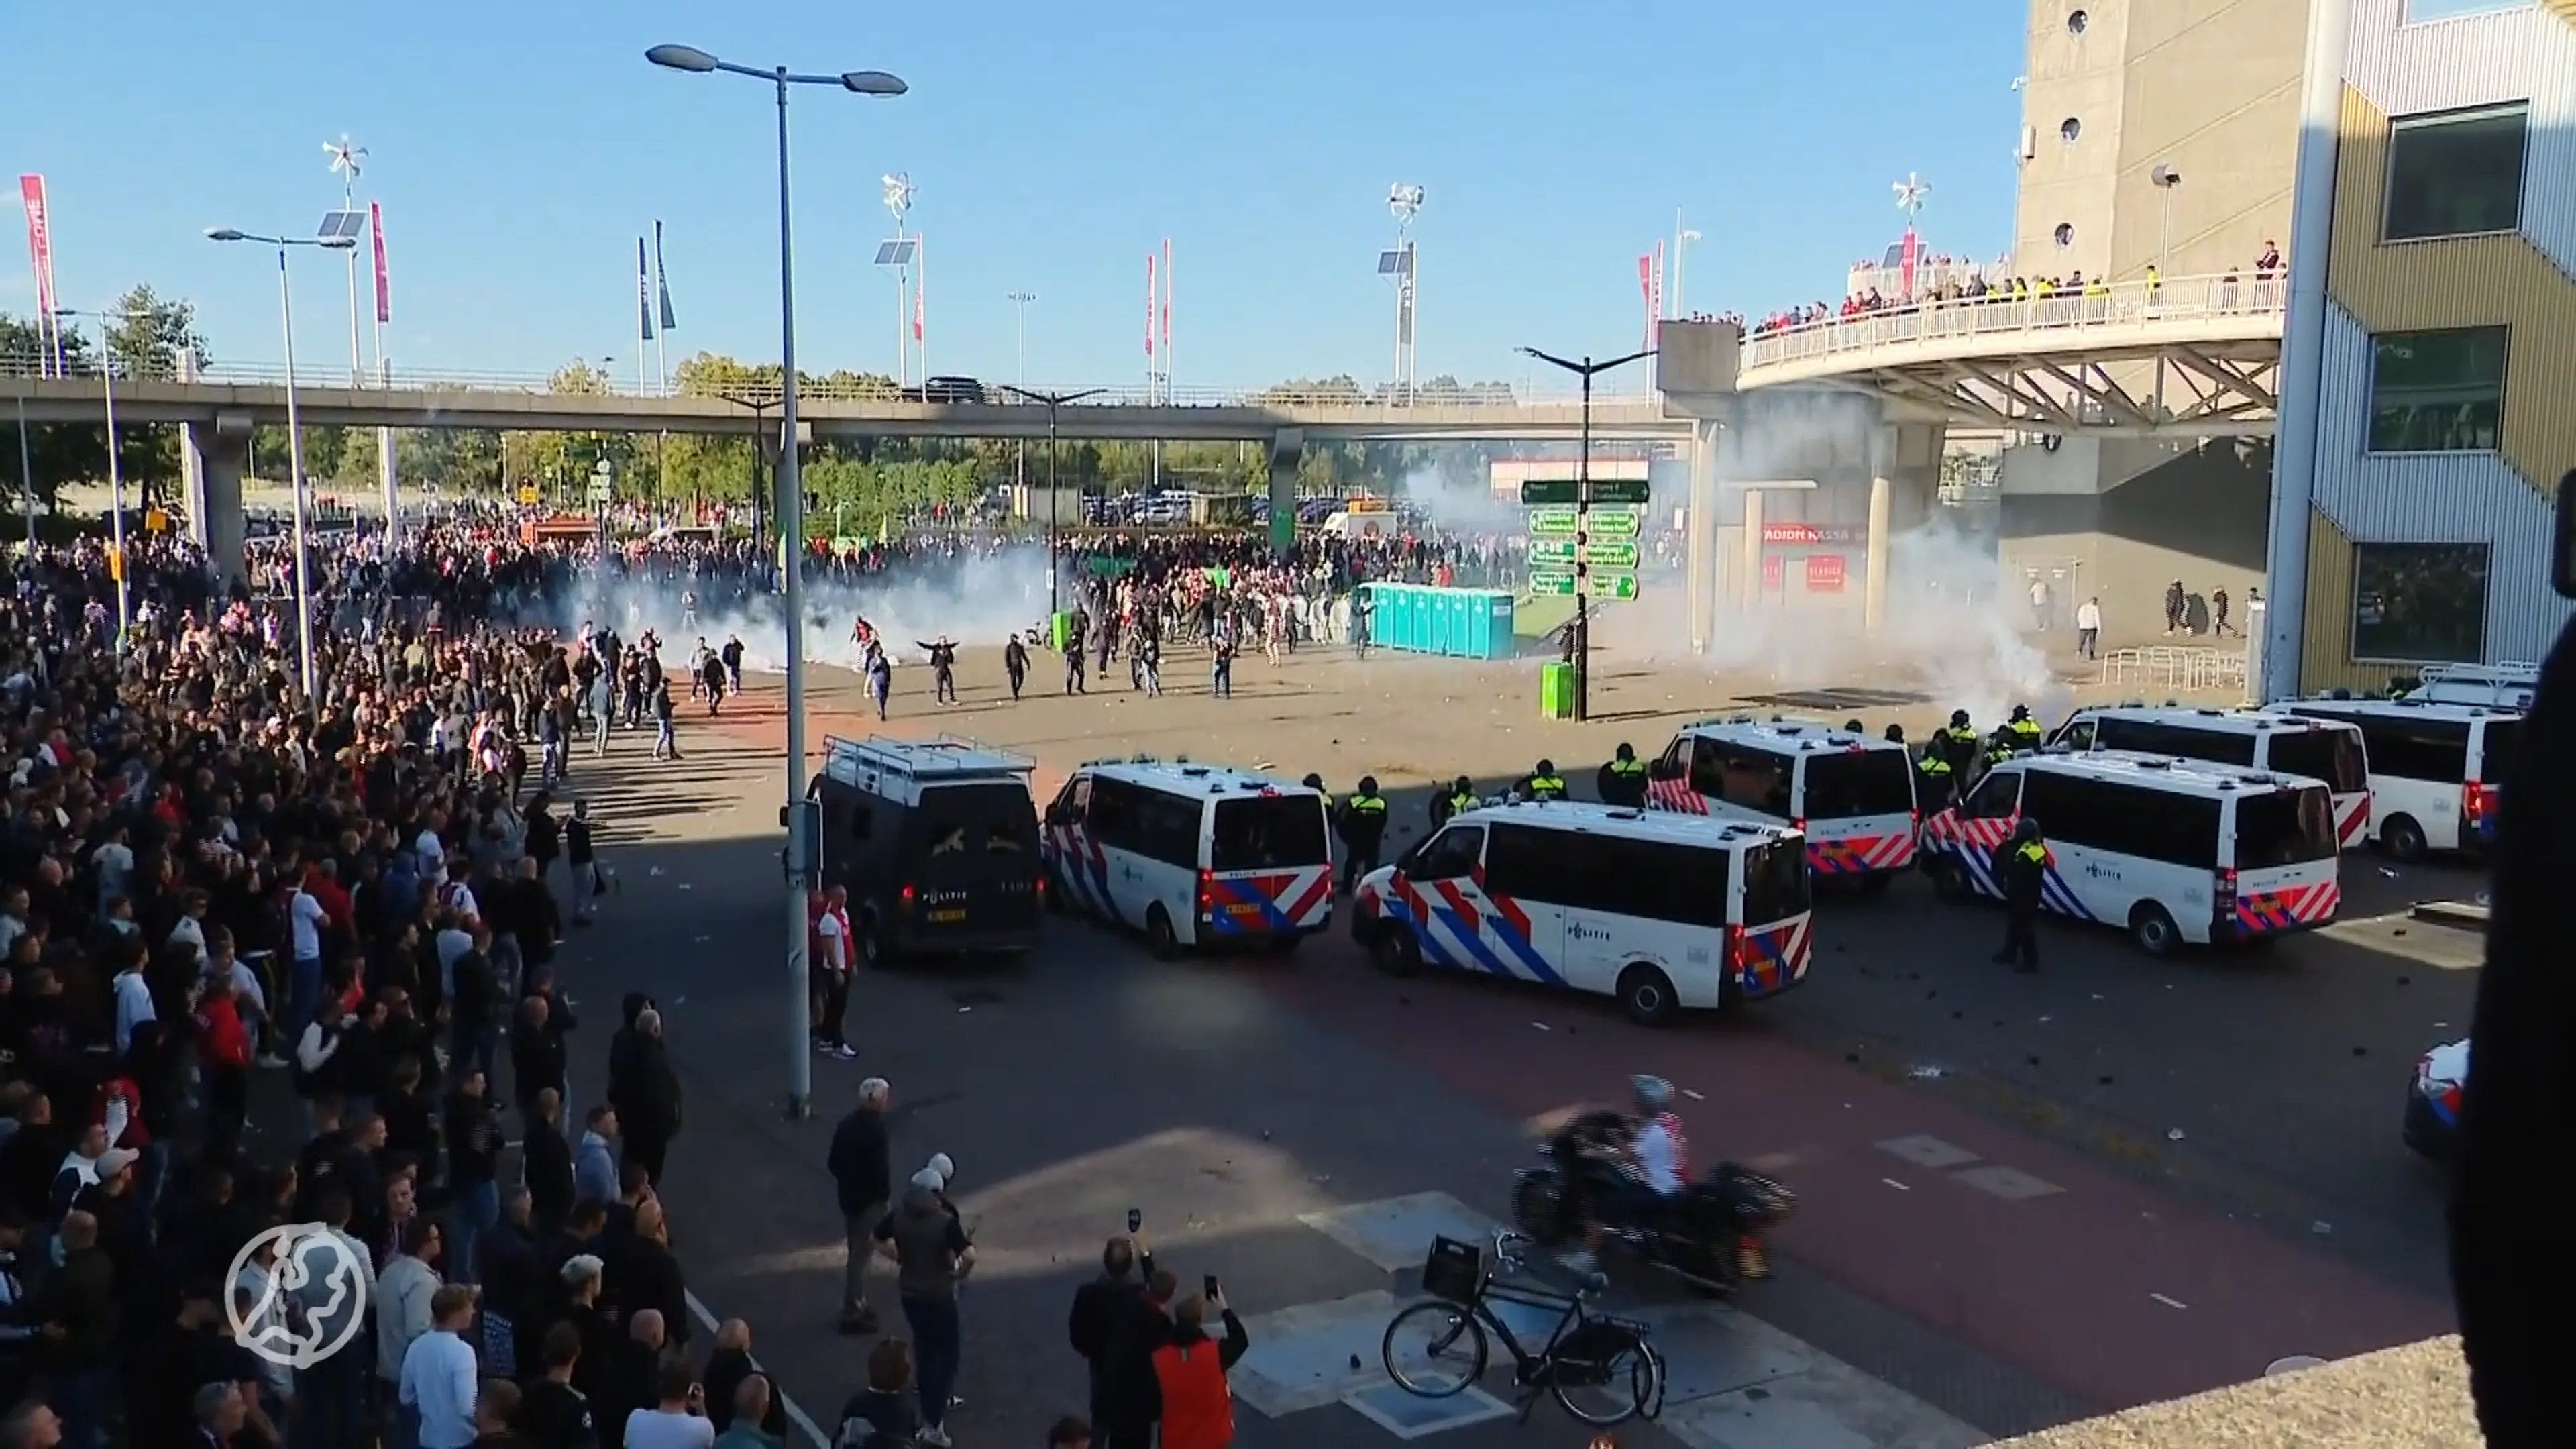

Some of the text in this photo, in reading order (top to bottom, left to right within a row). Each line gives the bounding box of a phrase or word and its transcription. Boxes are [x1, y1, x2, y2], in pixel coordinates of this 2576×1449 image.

[1807, 529, 1848, 541] KASSA
[922, 890, 967, 904] POLITIE
[1568, 922, 1610, 941] POLITIE
